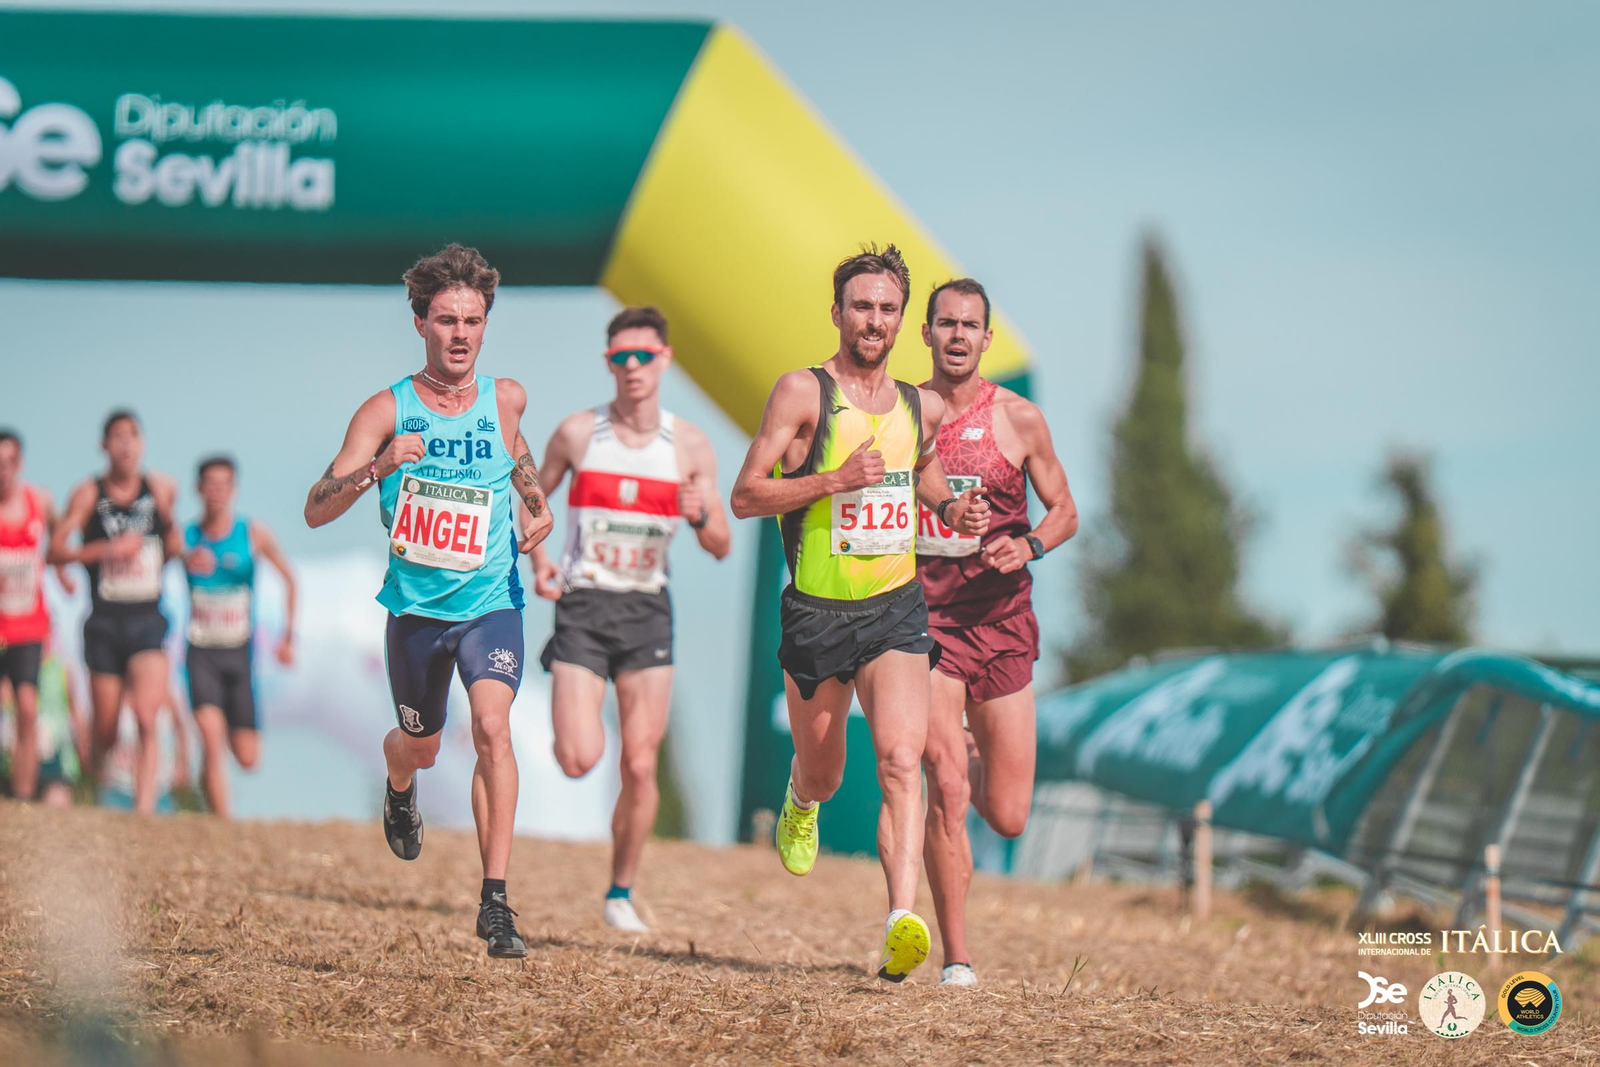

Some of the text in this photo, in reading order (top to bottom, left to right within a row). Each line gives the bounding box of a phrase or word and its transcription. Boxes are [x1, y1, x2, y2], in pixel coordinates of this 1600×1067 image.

[115, 93, 338, 144] Diputación
[113, 138, 336, 211] Sevilla
[403, 419, 429, 431] TROPS
[422, 431, 493, 465] erja
[416, 467, 482, 480] ATLETISMO
[425, 484, 468, 500] ITÁLICA
[392, 494, 482, 556] ÁNGEL
[840, 502, 908, 531] 5126
[592, 542, 658, 570] 5115
